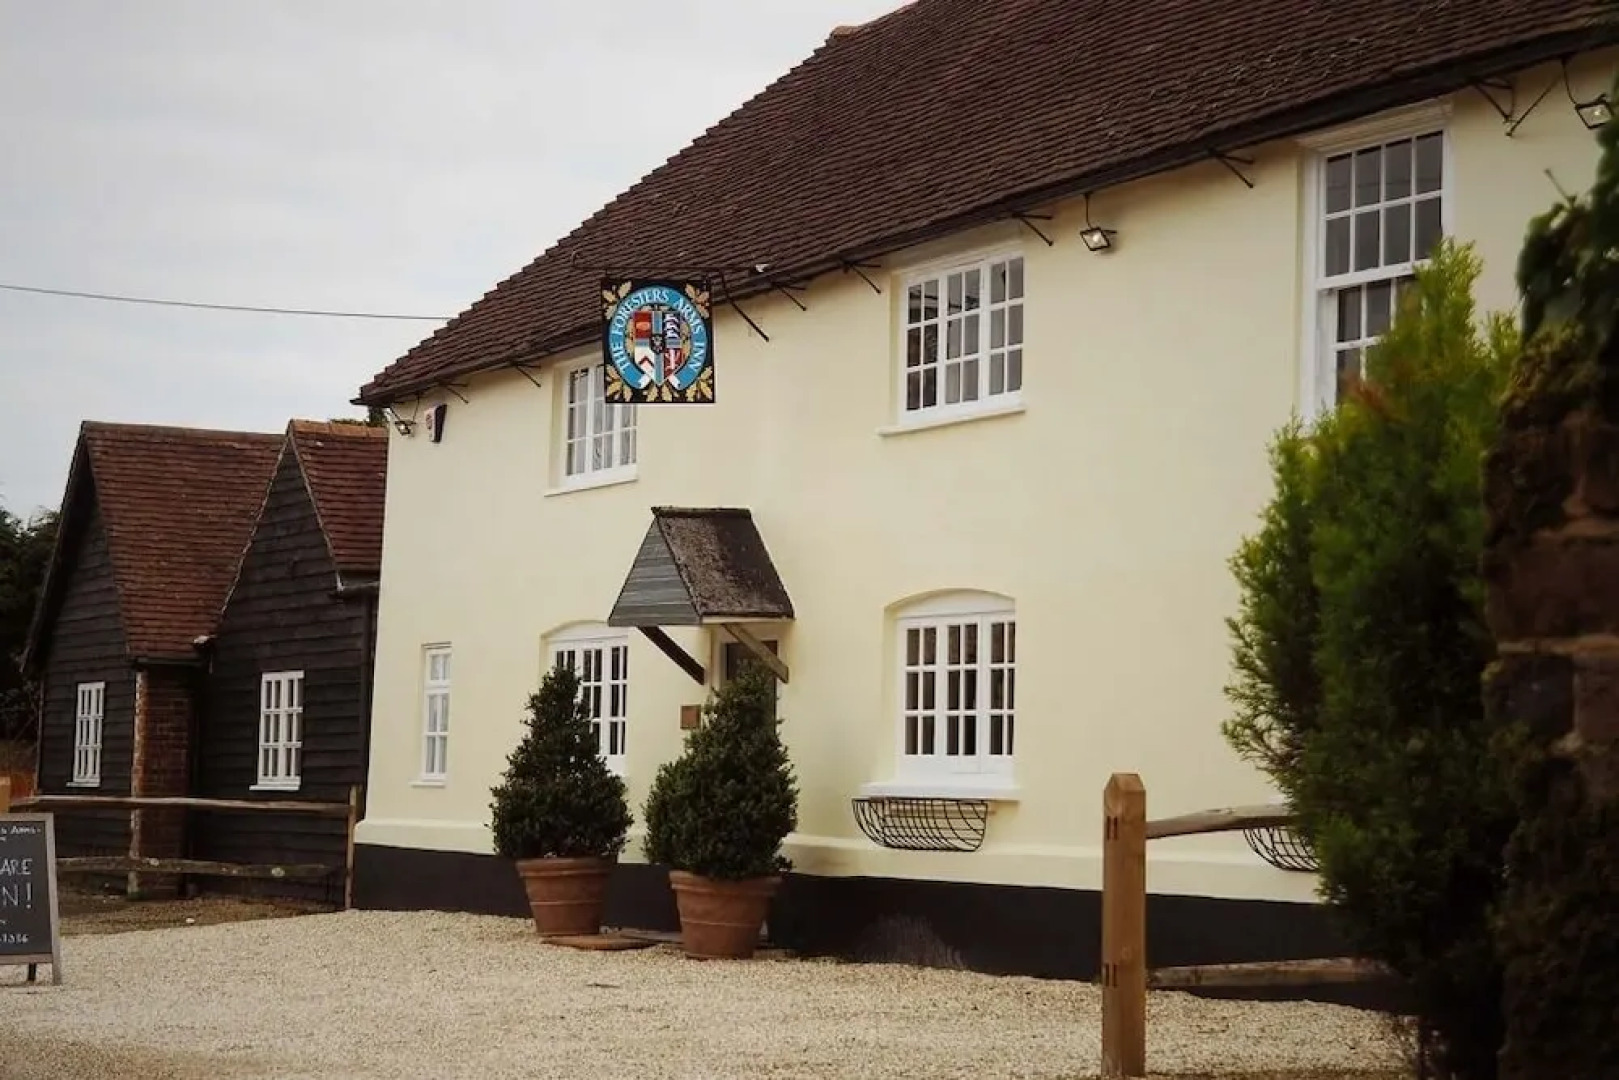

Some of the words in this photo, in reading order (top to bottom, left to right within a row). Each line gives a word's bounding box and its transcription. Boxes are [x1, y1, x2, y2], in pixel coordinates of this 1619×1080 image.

[614, 289, 670, 336] FORESTERS
[673, 298, 703, 335] ARMS
[611, 341, 630, 371] THE
[688, 342, 705, 370] INN
[0, 857, 33, 877] ARE
